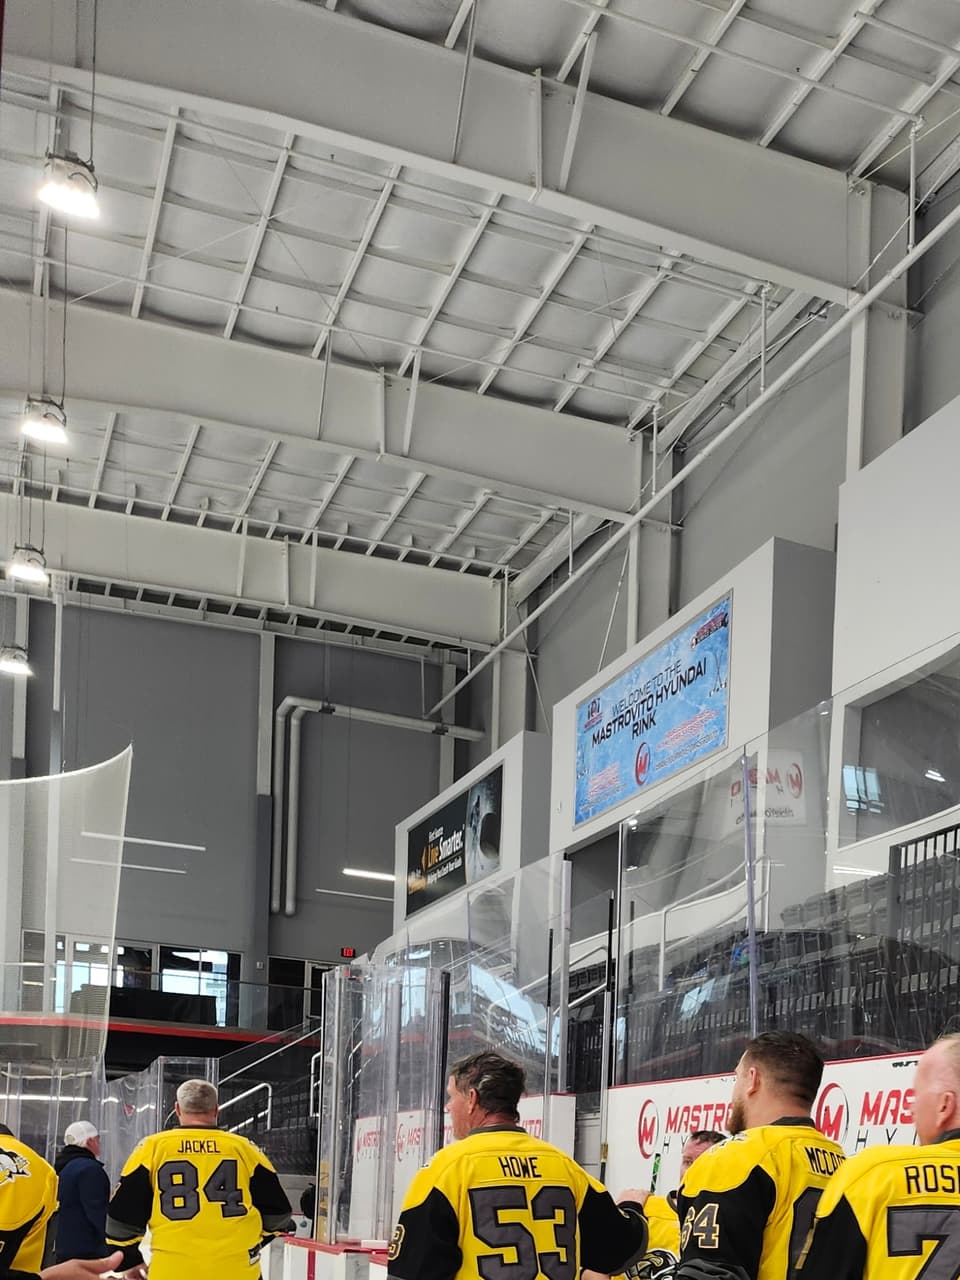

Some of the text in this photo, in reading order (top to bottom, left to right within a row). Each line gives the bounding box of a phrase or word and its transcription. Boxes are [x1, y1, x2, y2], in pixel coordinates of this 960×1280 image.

[592, 693, 654, 748] MASTROVITO
[655, 657, 707, 707] HYUNDAI
[612, 680, 652, 717] WELCOME
[652, 672, 664, 690] TO
[665, 659, 682, 685] THE
[632, 709, 657, 740] RINK
[177, 1140, 221, 1154] JACKEL
[498, 1156, 542, 1179] HOWE
[158, 1159, 249, 1221] 84
